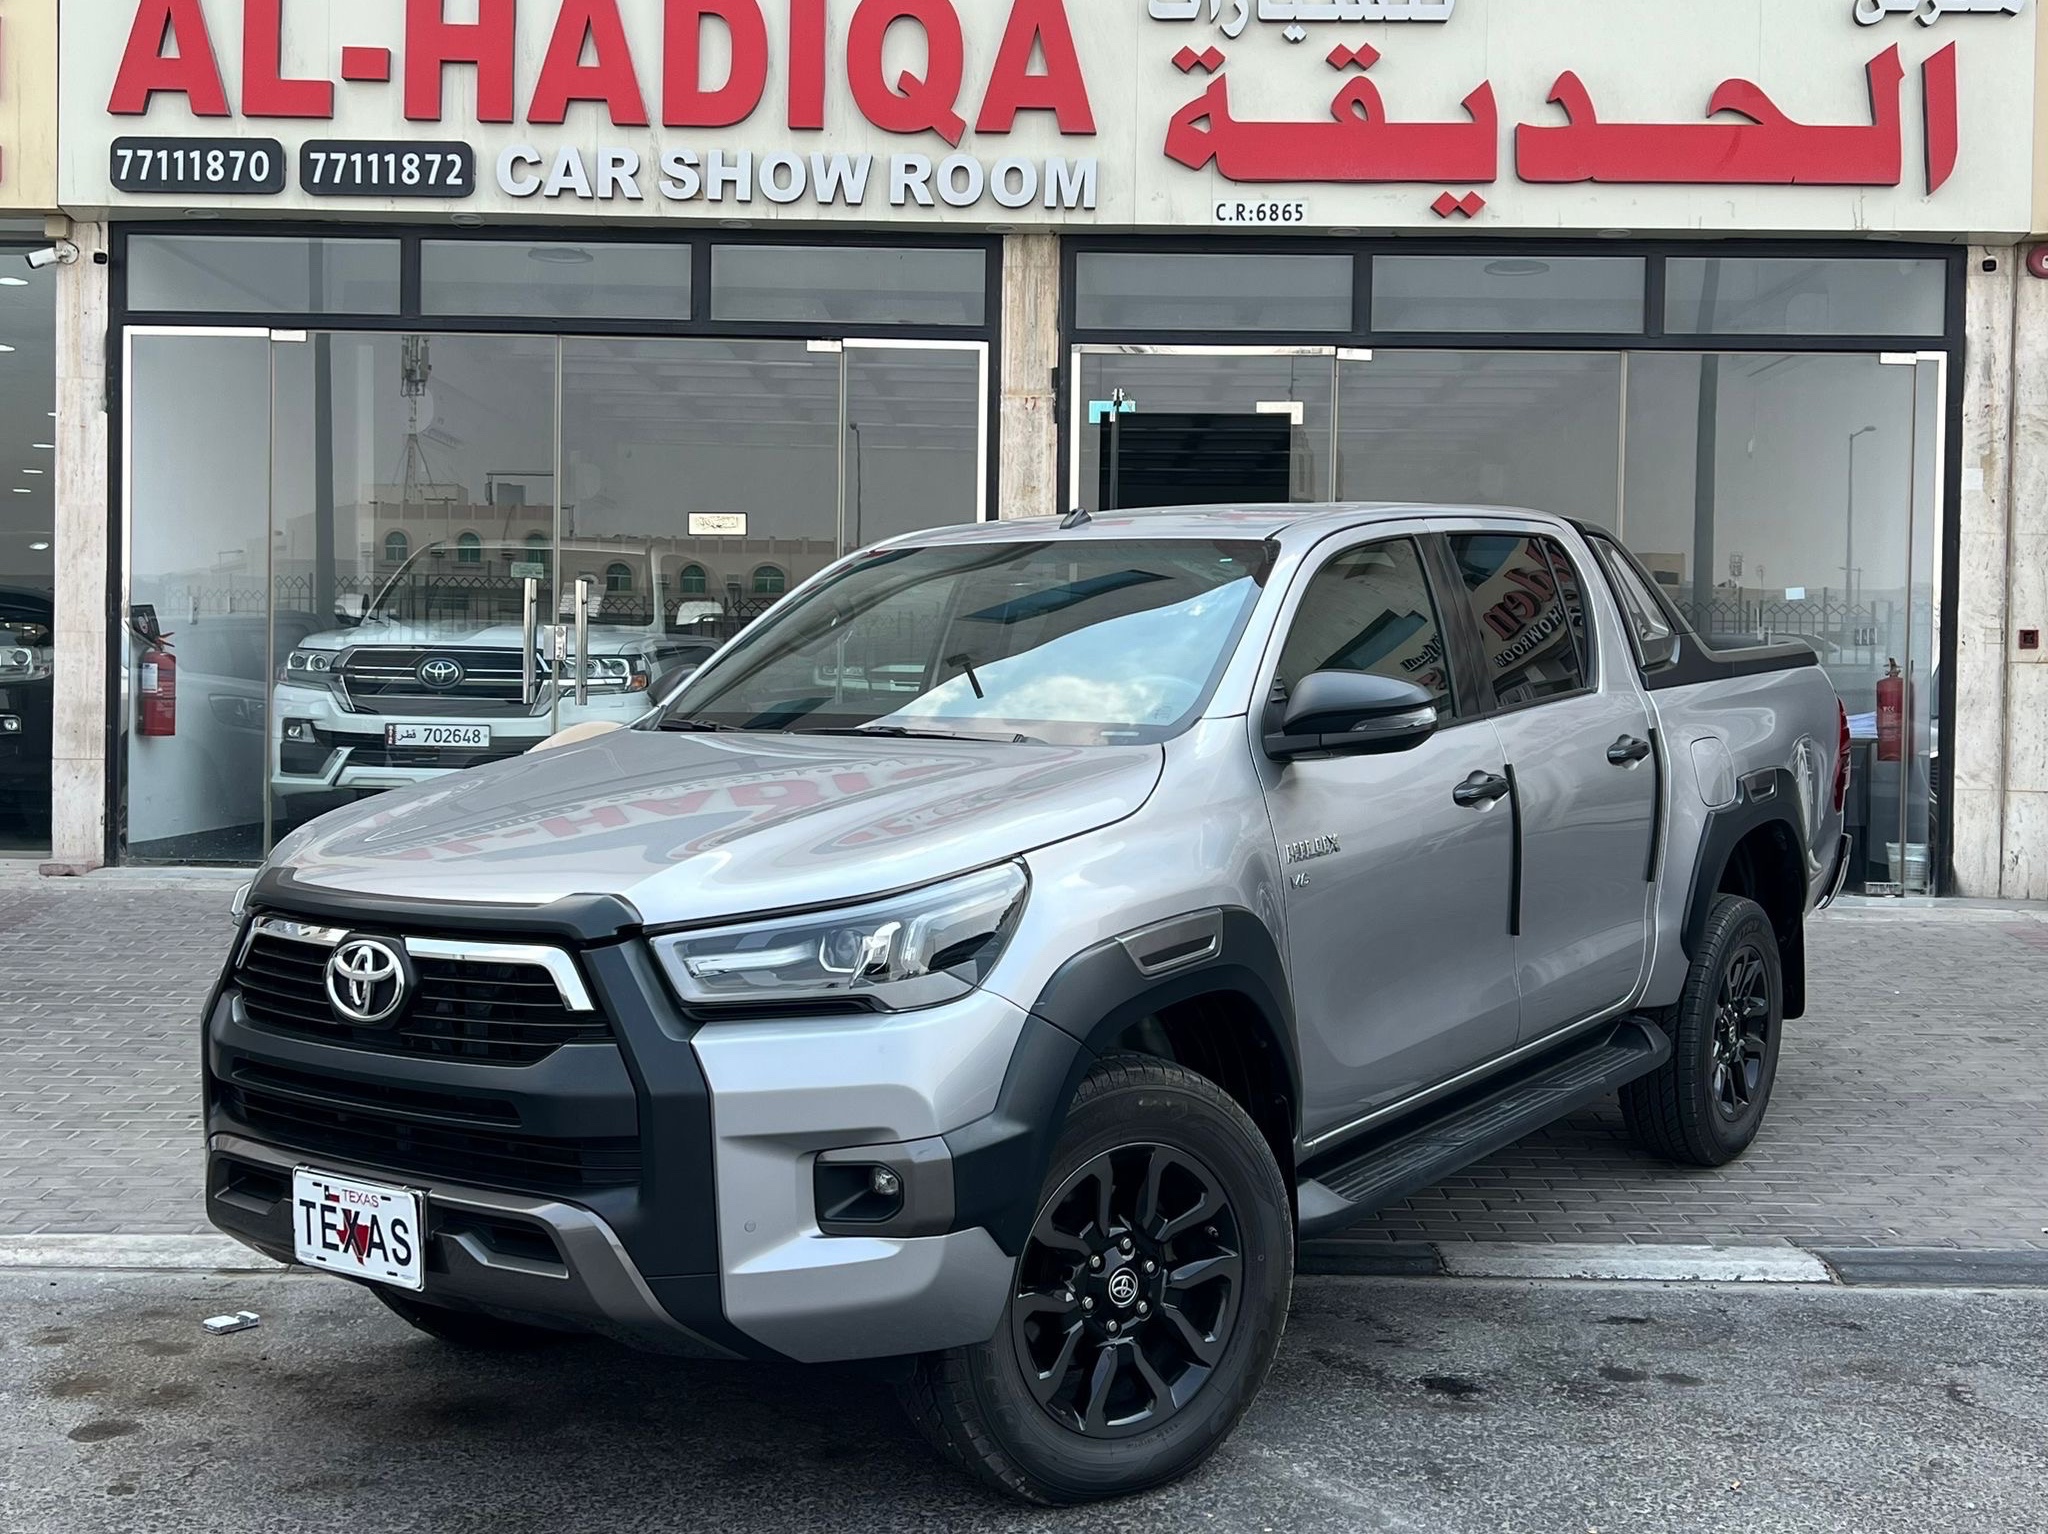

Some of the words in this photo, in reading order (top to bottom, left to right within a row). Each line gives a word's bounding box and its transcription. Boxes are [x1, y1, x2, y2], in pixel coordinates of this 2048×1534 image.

[107, 0, 1097, 148] AL-HADIQA
[1163, 40, 1958, 219] الحديقة
[116, 149, 270, 182] 77111870
[309, 152, 464, 186] 77111872
[496, 146, 643, 200] CAR
[657, 148, 872, 205] SHOW
[889, 152, 1097, 209] ROOM
[1216, 203, 1303, 221] C.R:6865
[423, 728, 481, 744] 702648
[341, 1189, 379, 1208] TEXAS
[299, 1198, 412, 1266] TEXAS
